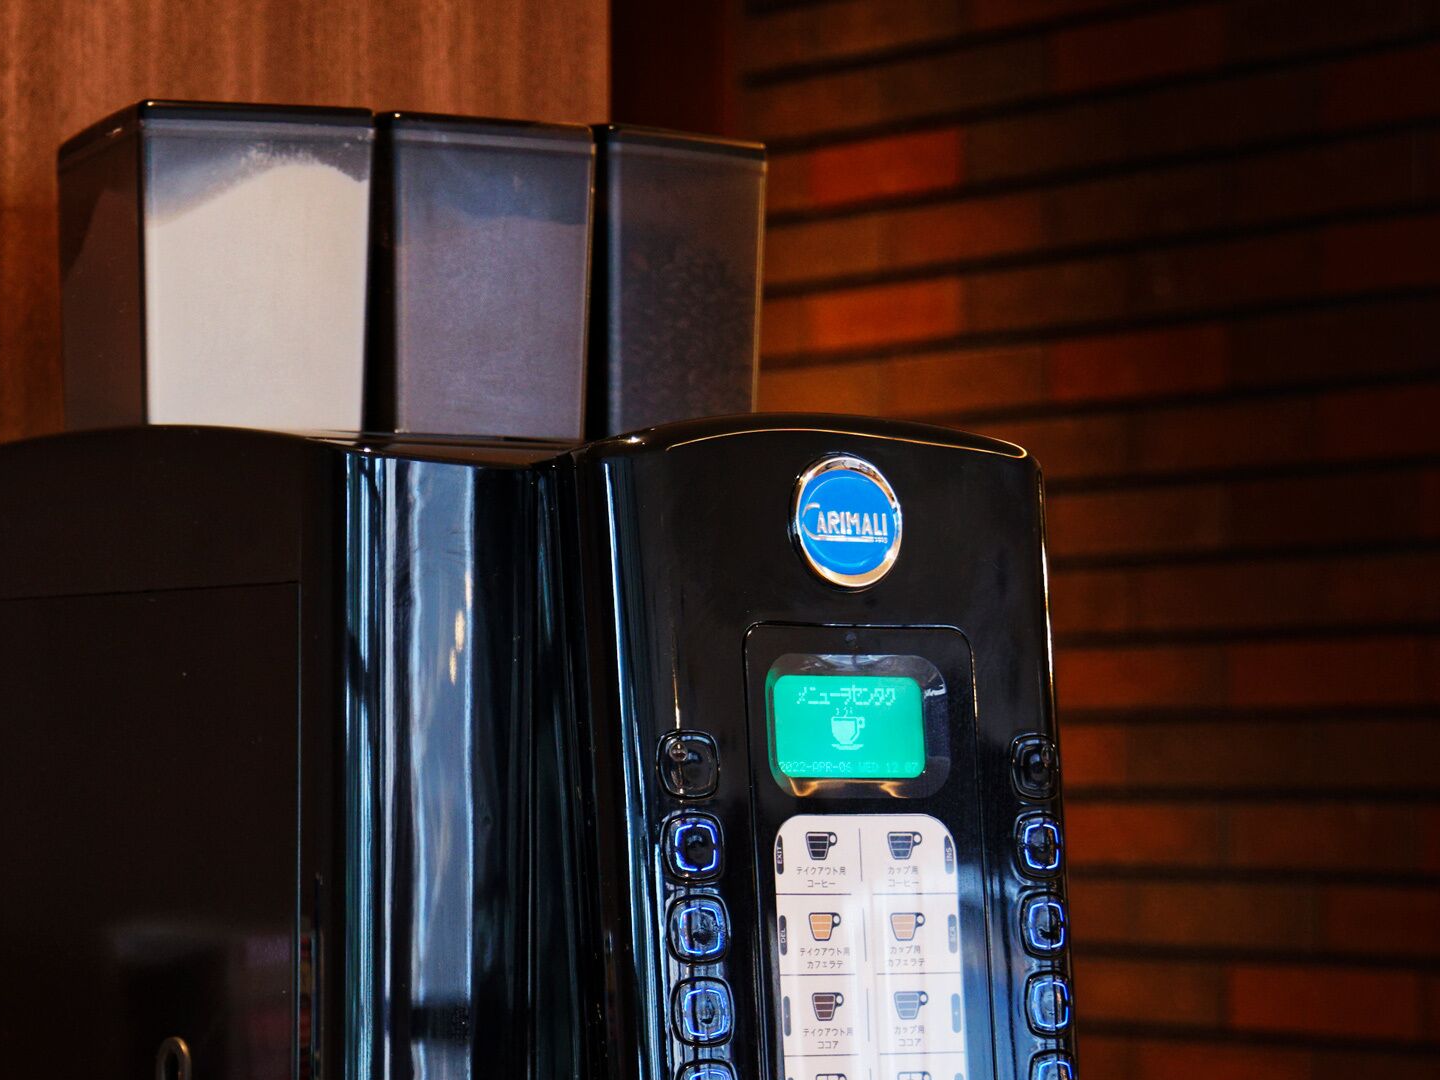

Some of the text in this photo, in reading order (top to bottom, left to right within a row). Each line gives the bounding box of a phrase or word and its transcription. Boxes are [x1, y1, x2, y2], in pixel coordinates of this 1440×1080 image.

[807, 880, 836, 888] コーヒー
[888, 879, 920, 887] コーヒー
[807, 960, 844, 969] カフェラテ
[817, 1041, 839, 1049] ココア
